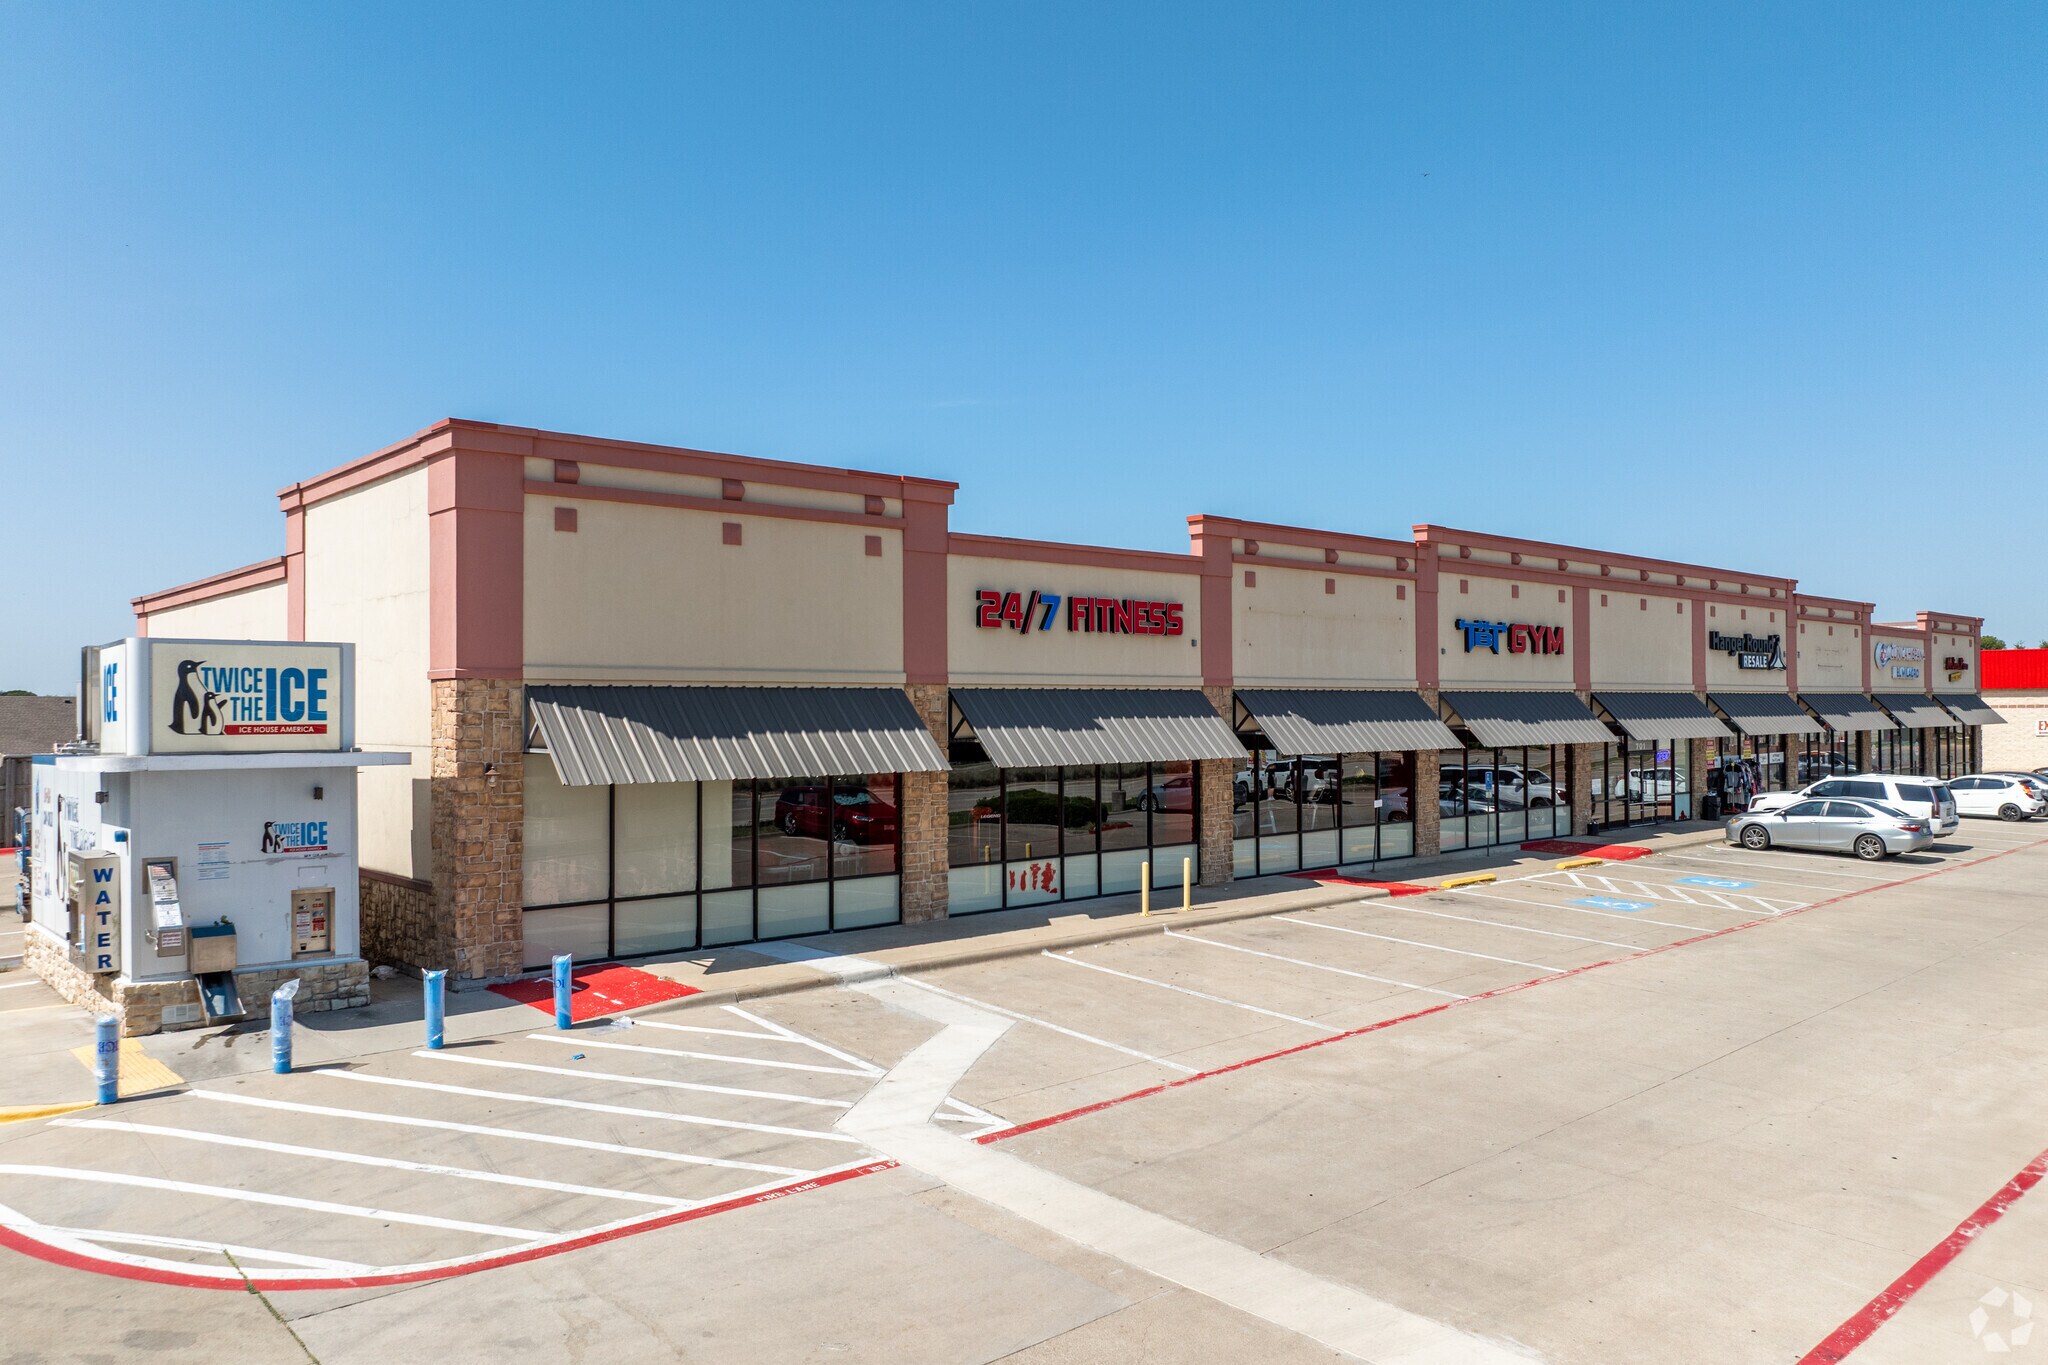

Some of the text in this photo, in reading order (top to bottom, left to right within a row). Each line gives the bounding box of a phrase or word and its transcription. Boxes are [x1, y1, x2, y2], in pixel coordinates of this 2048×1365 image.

[976, 590, 1183, 636] 24/7 FITNESS
[1508, 623, 1564, 655] GYM
[1710, 631, 1745, 656] Hanger
[1743, 655, 1767, 668] RESALE
[200, 667, 263, 693] TWICE
[103, 663, 118, 723] ICE
[266, 668, 328, 722] ICE
[230, 697, 263, 722] THE
[239, 725, 314, 734] ICE HOUSE AMERICA
[274, 823, 300, 835] TWICE
[286, 835, 300, 847] THE
[301, 822, 328, 845] ICE
[93, 867, 114, 970] WATER
